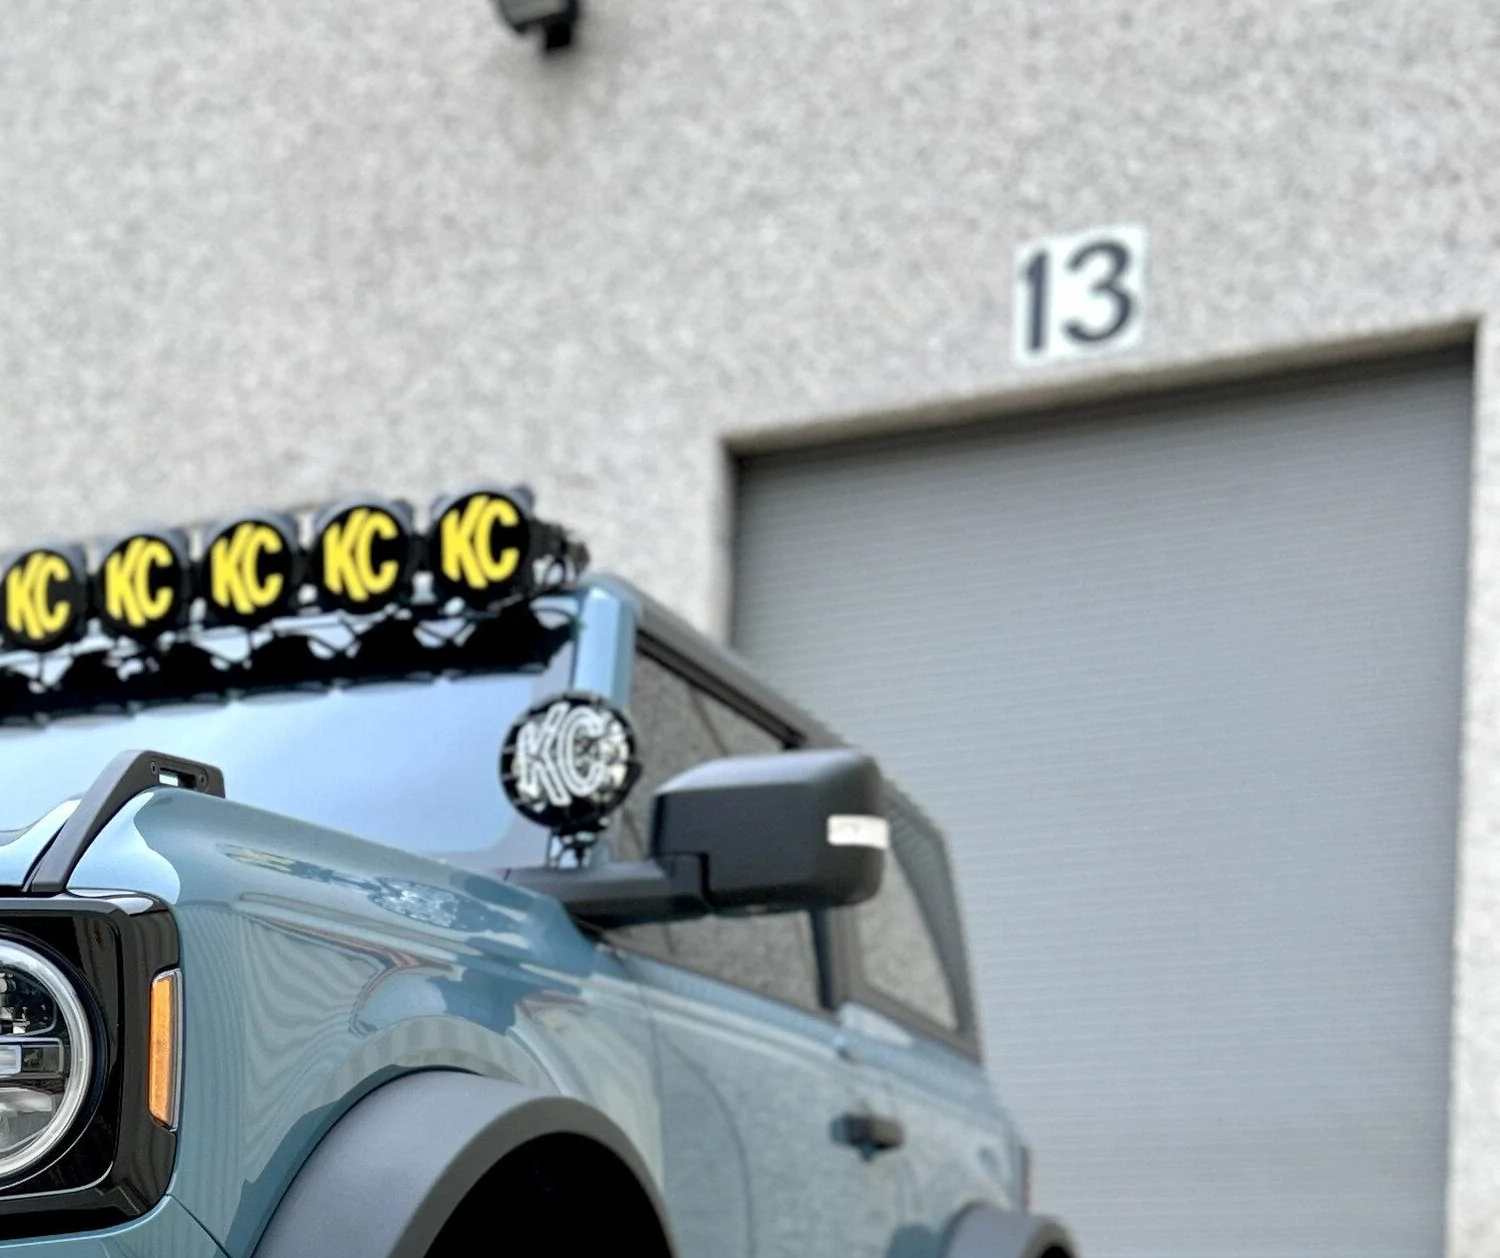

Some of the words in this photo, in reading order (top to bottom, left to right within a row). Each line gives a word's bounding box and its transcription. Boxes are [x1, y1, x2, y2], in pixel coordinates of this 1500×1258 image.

[1022, 238, 1136, 354] 13
[105, 536, 174, 628] KC
[211, 521, 284, 615] KC
[323, 507, 399, 602] KC
[441, 494, 520, 590] KC
[6, 553, 71, 640] KC
[514, 701, 608, 806] KC
